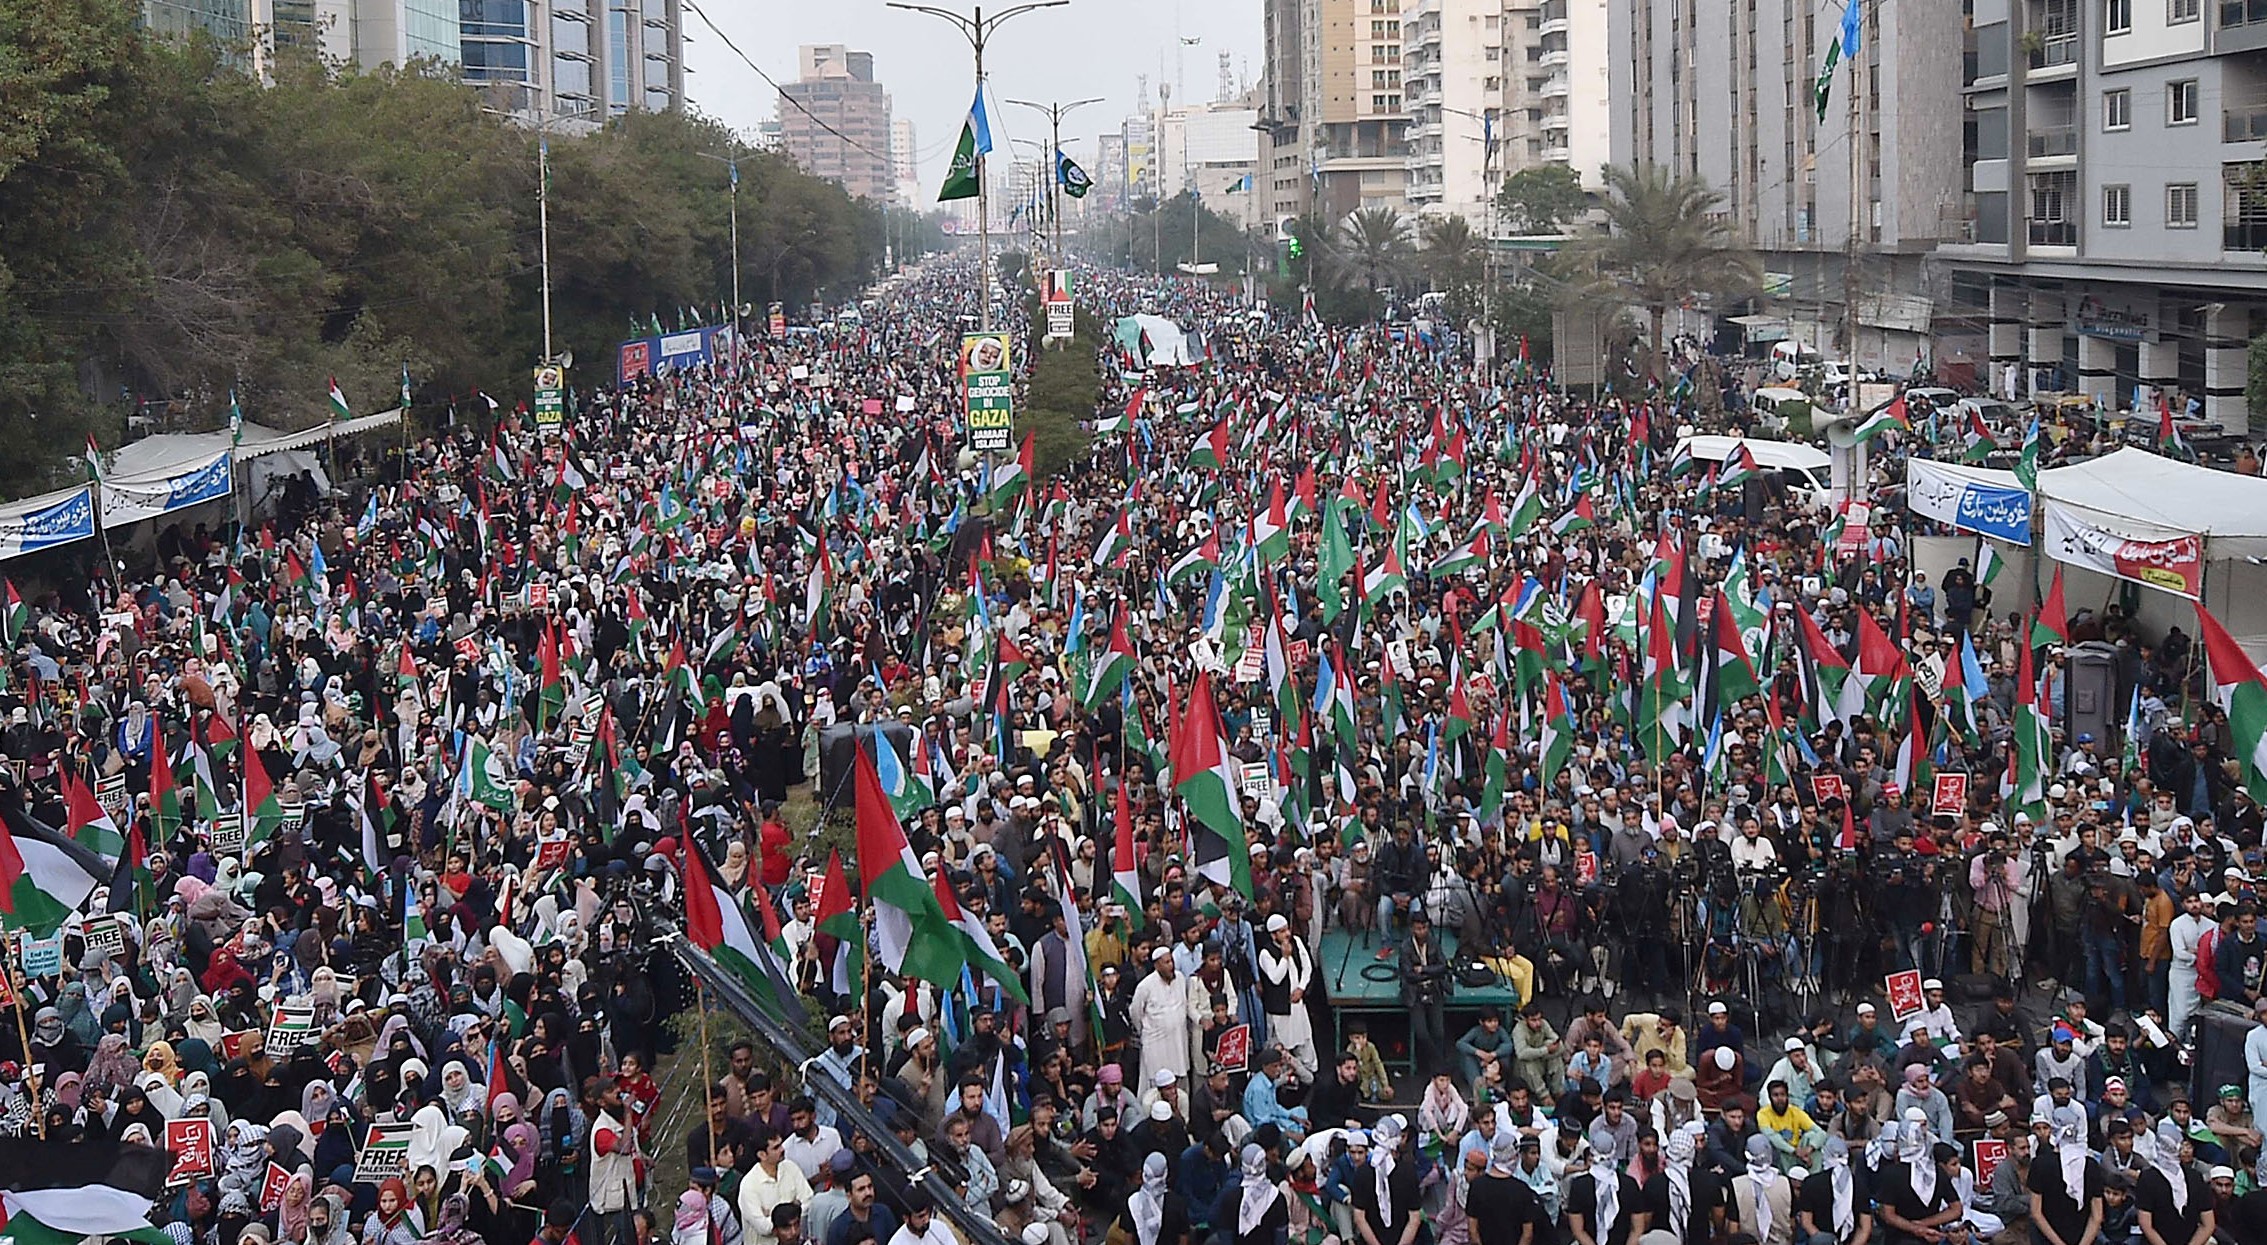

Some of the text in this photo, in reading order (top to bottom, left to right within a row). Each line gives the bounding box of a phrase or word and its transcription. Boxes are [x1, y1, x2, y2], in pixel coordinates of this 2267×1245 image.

[1048, 304, 1072, 314] FREE
[978, 376, 1000, 387] STOP
[968, 386, 1009, 398] GENOCIDE
[983, 398, 993, 408] IN
[536, 411, 562, 424] GAZA
[970, 409, 1010, 428] GAZA
[972, 429, 1008, 440] JAMAAT
[975, 439, 1006, 449] ISLAMI
[1245, 780, 1267, 791] FREE
[97, 789, 125, 804] FREE
[213, 830, 240, 843] FREE
[86, 930, 120, 948] FREE
[268, 1030, 307, 1046] FREE
[360, 1150, 407, 1165] FREE
